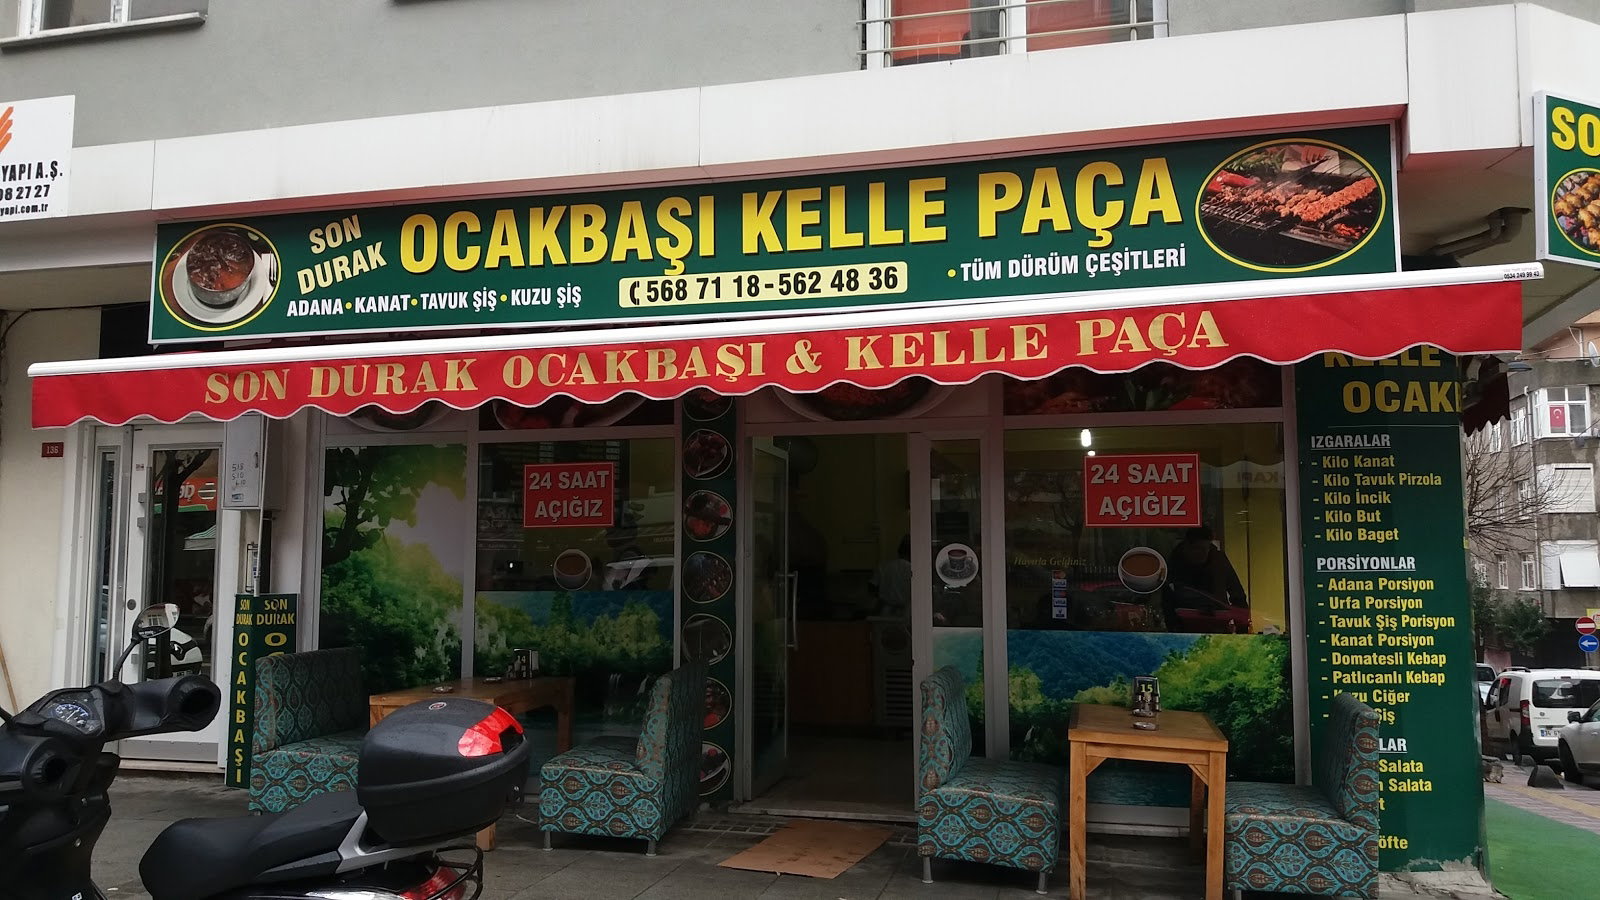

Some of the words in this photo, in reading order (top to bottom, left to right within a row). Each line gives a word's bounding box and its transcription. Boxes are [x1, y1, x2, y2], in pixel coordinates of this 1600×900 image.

[2, 163, 31, 182] YAPI
[36, 160, 63, 181] A.Ş.
[16, 186, 31, 200] 27
[34, 184, 50, 198] 27
[400, 195, 715, 275] OCAKBAŞI
[742, 177, 947, 255] KELLE
[978, 157, 1183, 248] PAÇA
[309, 214, 362, 254] SON
[297, 241, 388, 295] DURAK
[961, 257, 1001, 281] TÜM
[1008, 252, 1078, 278] DÜRÜM
[1085, 243, 1186, 278] ÇEŞİTLERİ
[647, 278, 688, 303] 568
[697, 276, 721, 299] 71
[830, 268, 859, 292] 48
[869, 266, 898, 290] 36
[287, 299, 343, 317] ADANA
[355, 294, 411, 314] KANAT
[420, 292, 469, 310] TAVUK
[473, 286, 497, 312] ŞİŞ
[511, 288, 551, 306] KUZU
[557, 282, 582, 308] ŞİŞ
[204, 369, 290, 404] SON
[307, 357, 478, 398] DURAK
[502, 342, 767, 388] OCAKBAŞI
[786, 338, 822, 374] &
[845, 323, 1048, 370] KELLE
[1076, 310, 1229, 356] PAÇA
[1311, 434, 1391, 449] IZGARALAR
[1322, 456, 1349, 469] Kilo
[1354, 455, 1395, 468] Kanat
[529, 472, 552, 490] 24
[558, 470, 609, 489] SAAT
[1090, 464, 1120, 484] 24
[1128, 463, 1193, 484] SAAT
[1323, 474, 1350, 486] Kilo
[1354, 473, 1395, 486] Tavuk
[1399, 472, 1442, 486] Pirzola
[1324, 492, 1350, 505] Kilo
[1355, 488, 1391, 504] İncik
[534, 496, 603, 522] AÇIĞIZ
[1099, 491, 1186, 520] AÇIĞIZ
[1325, 510, 1351, 523] Kilo
[1356, 509, 1381, 523] But
[1326, 528, 1353, 541] Kilo
[1357, 528, 1399, 543] Baget
[1317, 554, 1416, 570] PORSİYONLAR
[1328, 578, 1373, 591] Adana
[1378, 577, 1434, 592] Porsiyon
[240, 598, 250, 611] SON
[264, 598, 287, 611] SON
[1329, 596, 1360, 609] Urfa
[1365, 596, 1423, 611] Porsiyon
[236, 613, 252, 626] DURAK
[256, 612, 295, 626] DURAK
[1329, 615, 1371, 628] Tavuk
[1376, 614, 1397, 631] Şiş
[1401, 615, 1455, 630] Porisyon
[1331, 634, 1373, 647] Kanat
[1378, 633, 1434, 648] Porsiyon
[1332, 652, 1403, 665] Domatesli
[1407, 652, 1447, 667] Kebap
[1333, 671, 1402, 684] Patlıcanlı
[1406, 671, 1445, 686] Kebap
[1140, 683, 1153, 693] 15
[1372, 689, 1410, 705] Ciğer
[1379, 759, 1424, 773] Salata
[1389, 778, 1432, 792] Salata
